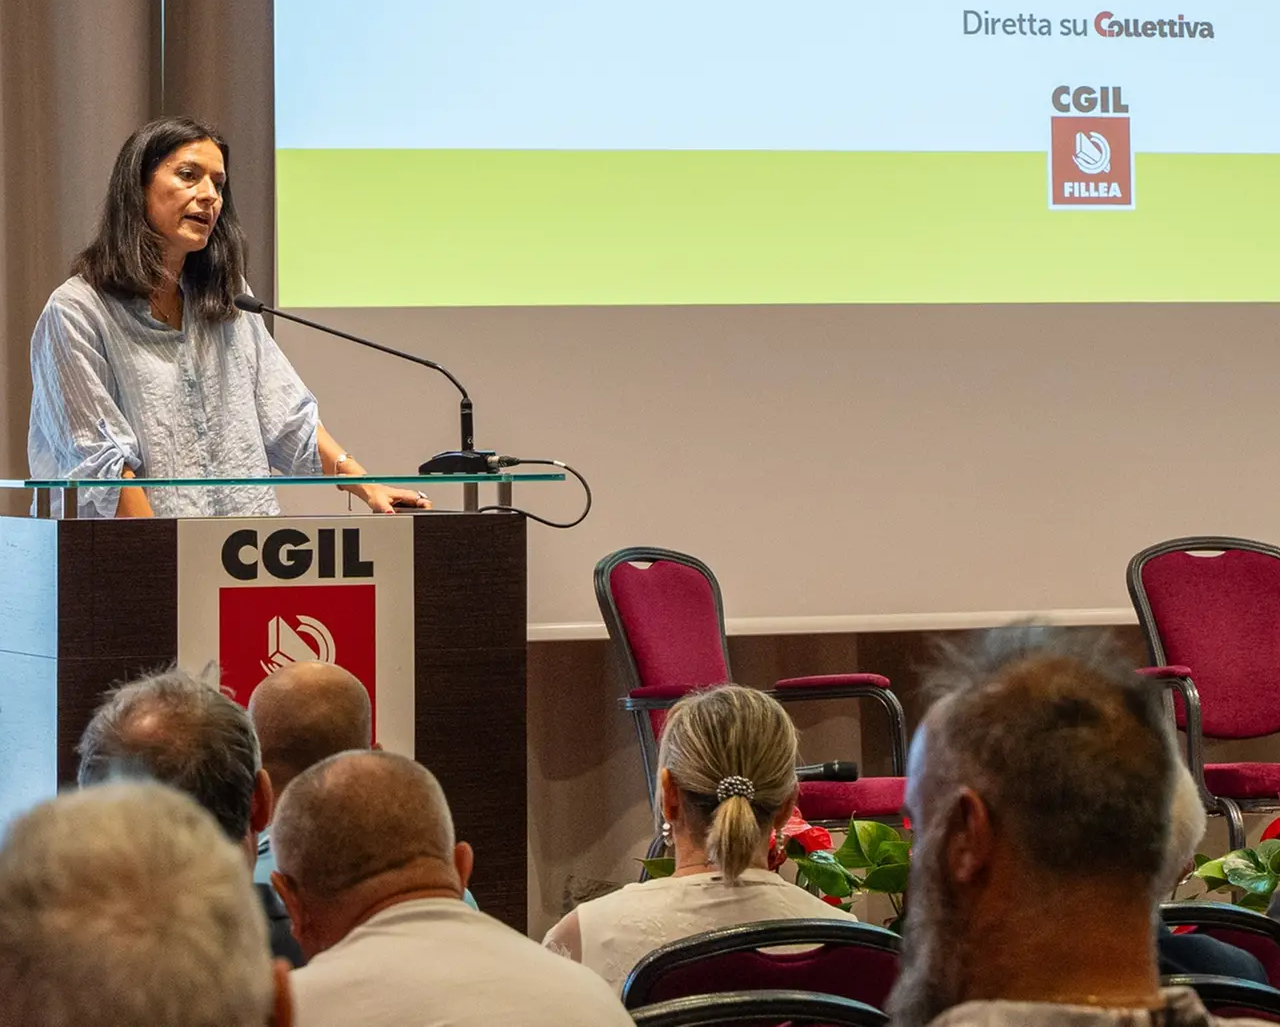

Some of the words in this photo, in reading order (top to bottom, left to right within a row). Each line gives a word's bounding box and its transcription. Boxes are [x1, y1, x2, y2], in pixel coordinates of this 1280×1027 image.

[962, 9, 1053, 38] Diretta
[1059, 17, 1088, 37] su
[1094, 10, 1215, 40] Collettiva
[1051, 84, 1129, 114] CGIL
[1063, 181, 1122, 199] FILLEA
[220, 527, 375, 581] CGIL
